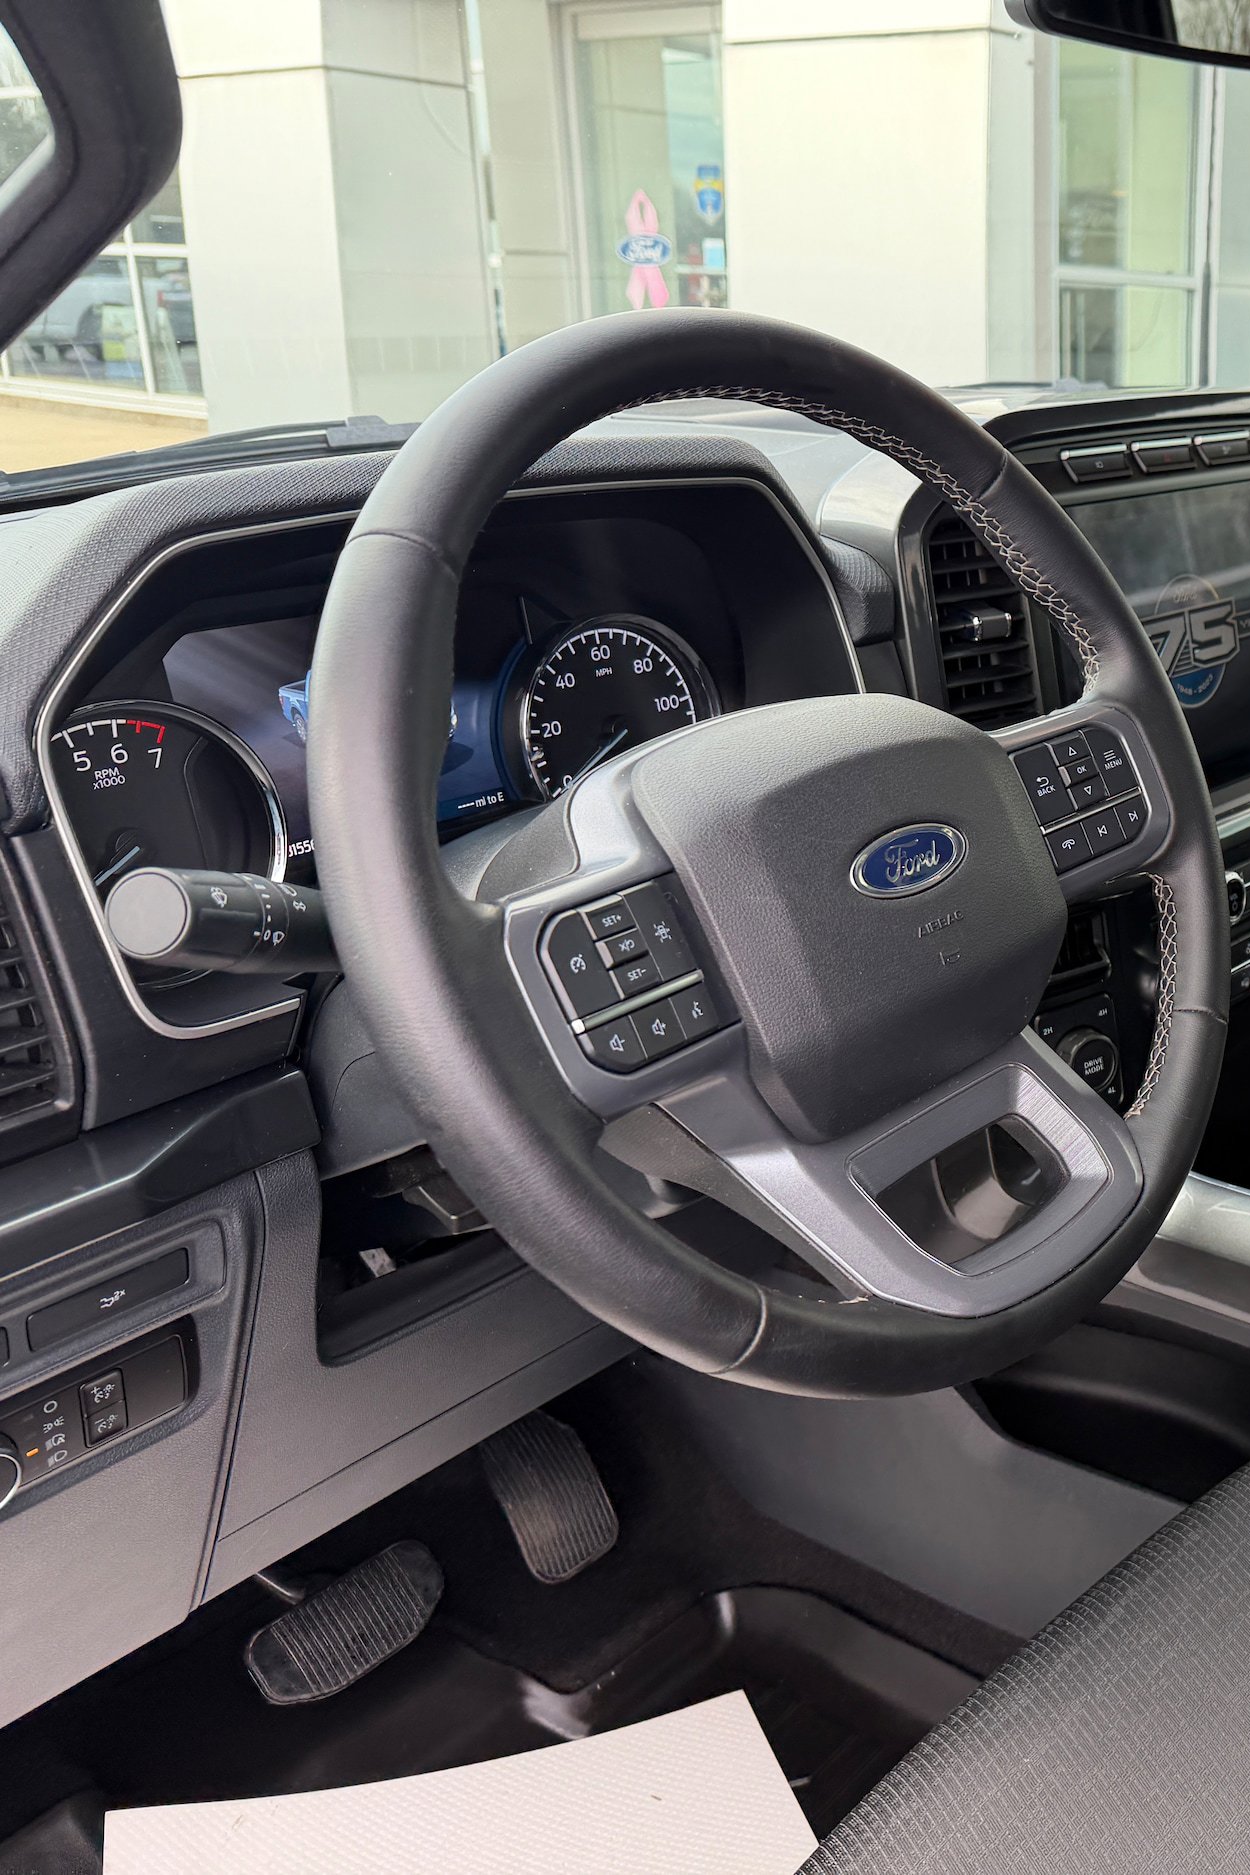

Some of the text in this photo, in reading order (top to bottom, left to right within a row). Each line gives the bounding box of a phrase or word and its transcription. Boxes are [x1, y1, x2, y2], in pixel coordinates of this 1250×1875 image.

[1143, 601, 1238, 677] 75
[590, 644, 611, 661] 60
[595, 667, 613, 678] MPH
[633, 658, 653, 674] 80
[555, 673, 575, 689] 40
[654, 694, 680, 712] 100
[541, 720, 562, 738] 20
[72, 750, 92, 772] 5
[110, 744, 129, 764] 6
[147, 747, 164, 769] 7
[1076, 765, 1087, 774] OK
[1104, 759, 1122, 770] MENU
[94, 766, 120, 781] RPM
[93, 775, 126, 790] x1000
[1037, 785, 1056, 797] BACK
[487, 795, 498, 806] to
[497, 792, 505, 802] E
[884, 839, 941, 883] Ford
[602, 914, 622, 927] SET+
[1042, 1026, 1054, 1036] 2H
[1084, 1056, 1104, 1069] DRIVE
[1084, 1063, 1105, 1076] MODE
